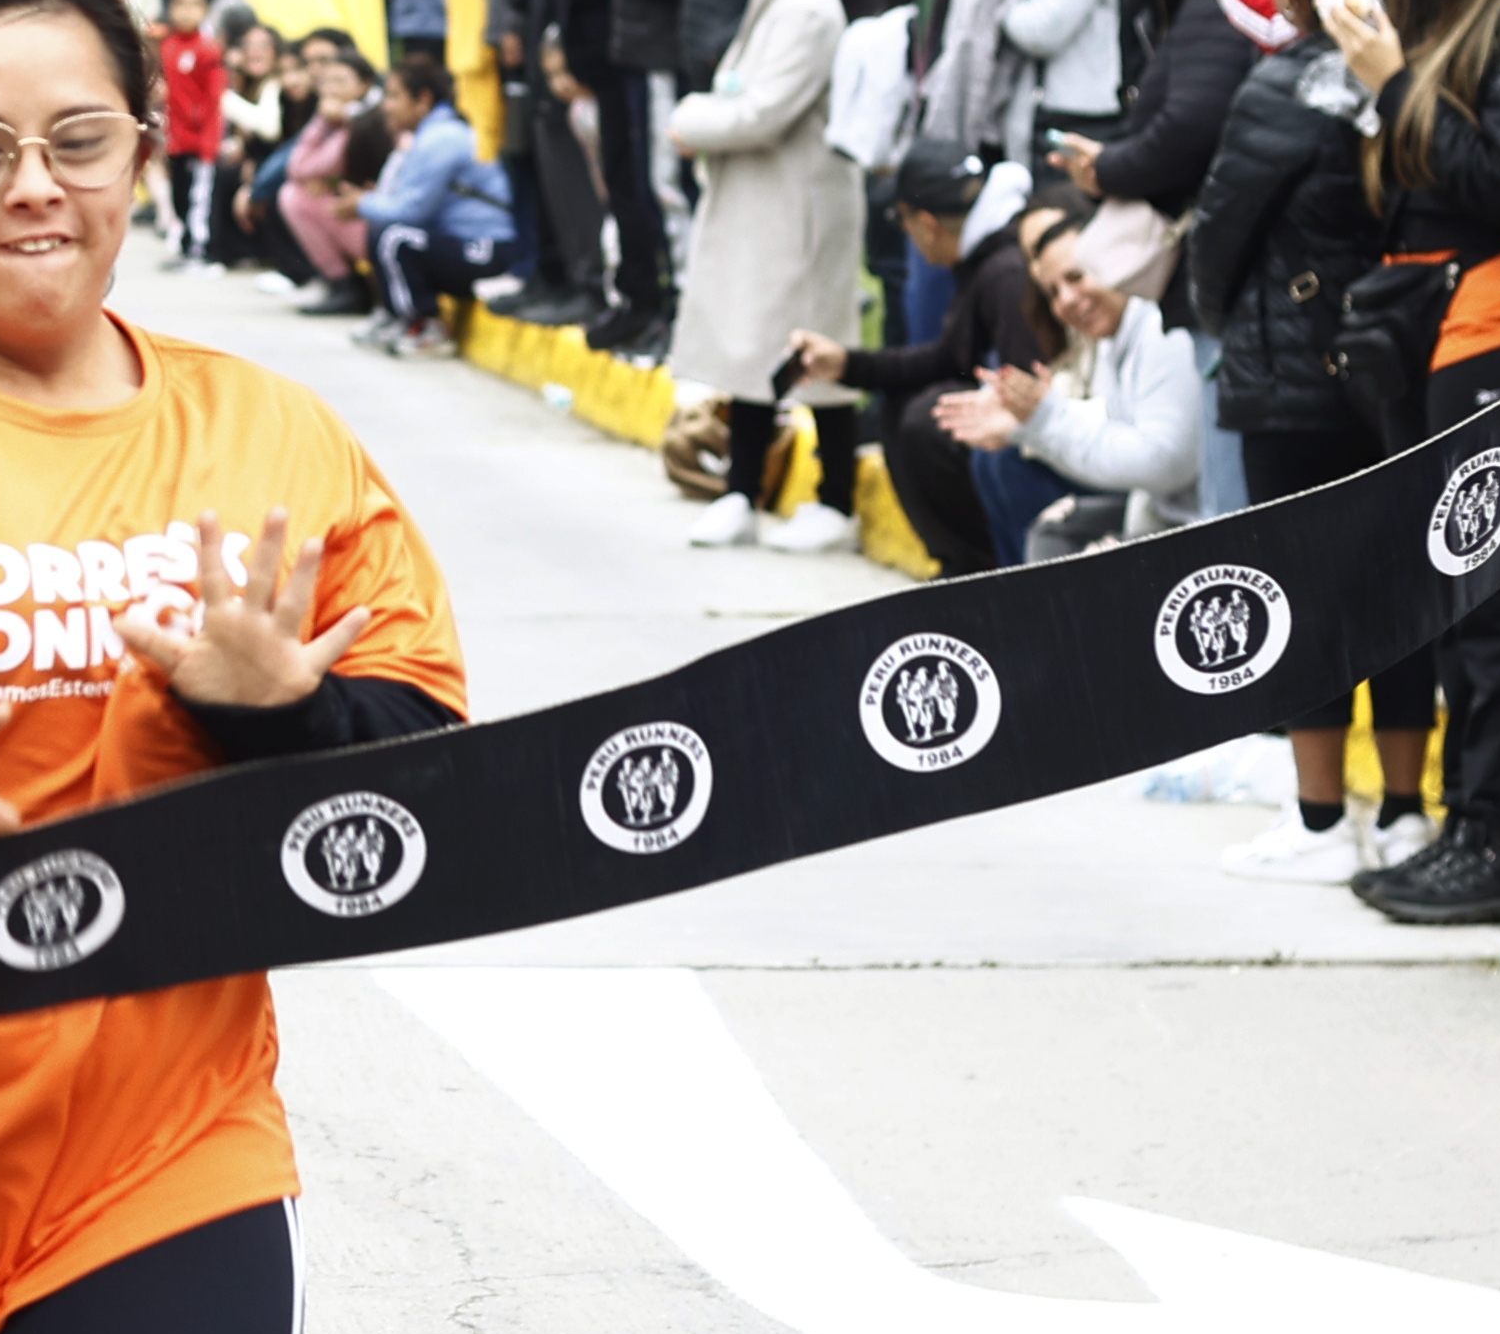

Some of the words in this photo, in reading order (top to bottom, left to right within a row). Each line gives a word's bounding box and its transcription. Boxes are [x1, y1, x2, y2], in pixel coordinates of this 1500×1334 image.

[1433, 477, 1458, 531] PERU
[1464, 539, 1499, 570] 1984
[1159, 584, 1192, 638] PERU
[1192, 566, 1283, 607] RUNNERS
[865, 654, 897, 707] PERU
[899, 637, 990, 683] RUNNERS
[1208, 665, 1256, 691] 1984
[586, 742, 620, 791] PERU
[623, 724, 704, 762] RUNNERS
[917, 743, 965, 769] 1984
[330, 793, 417, 840] RUNNERS
[632, 826, 681, 851] 1984
